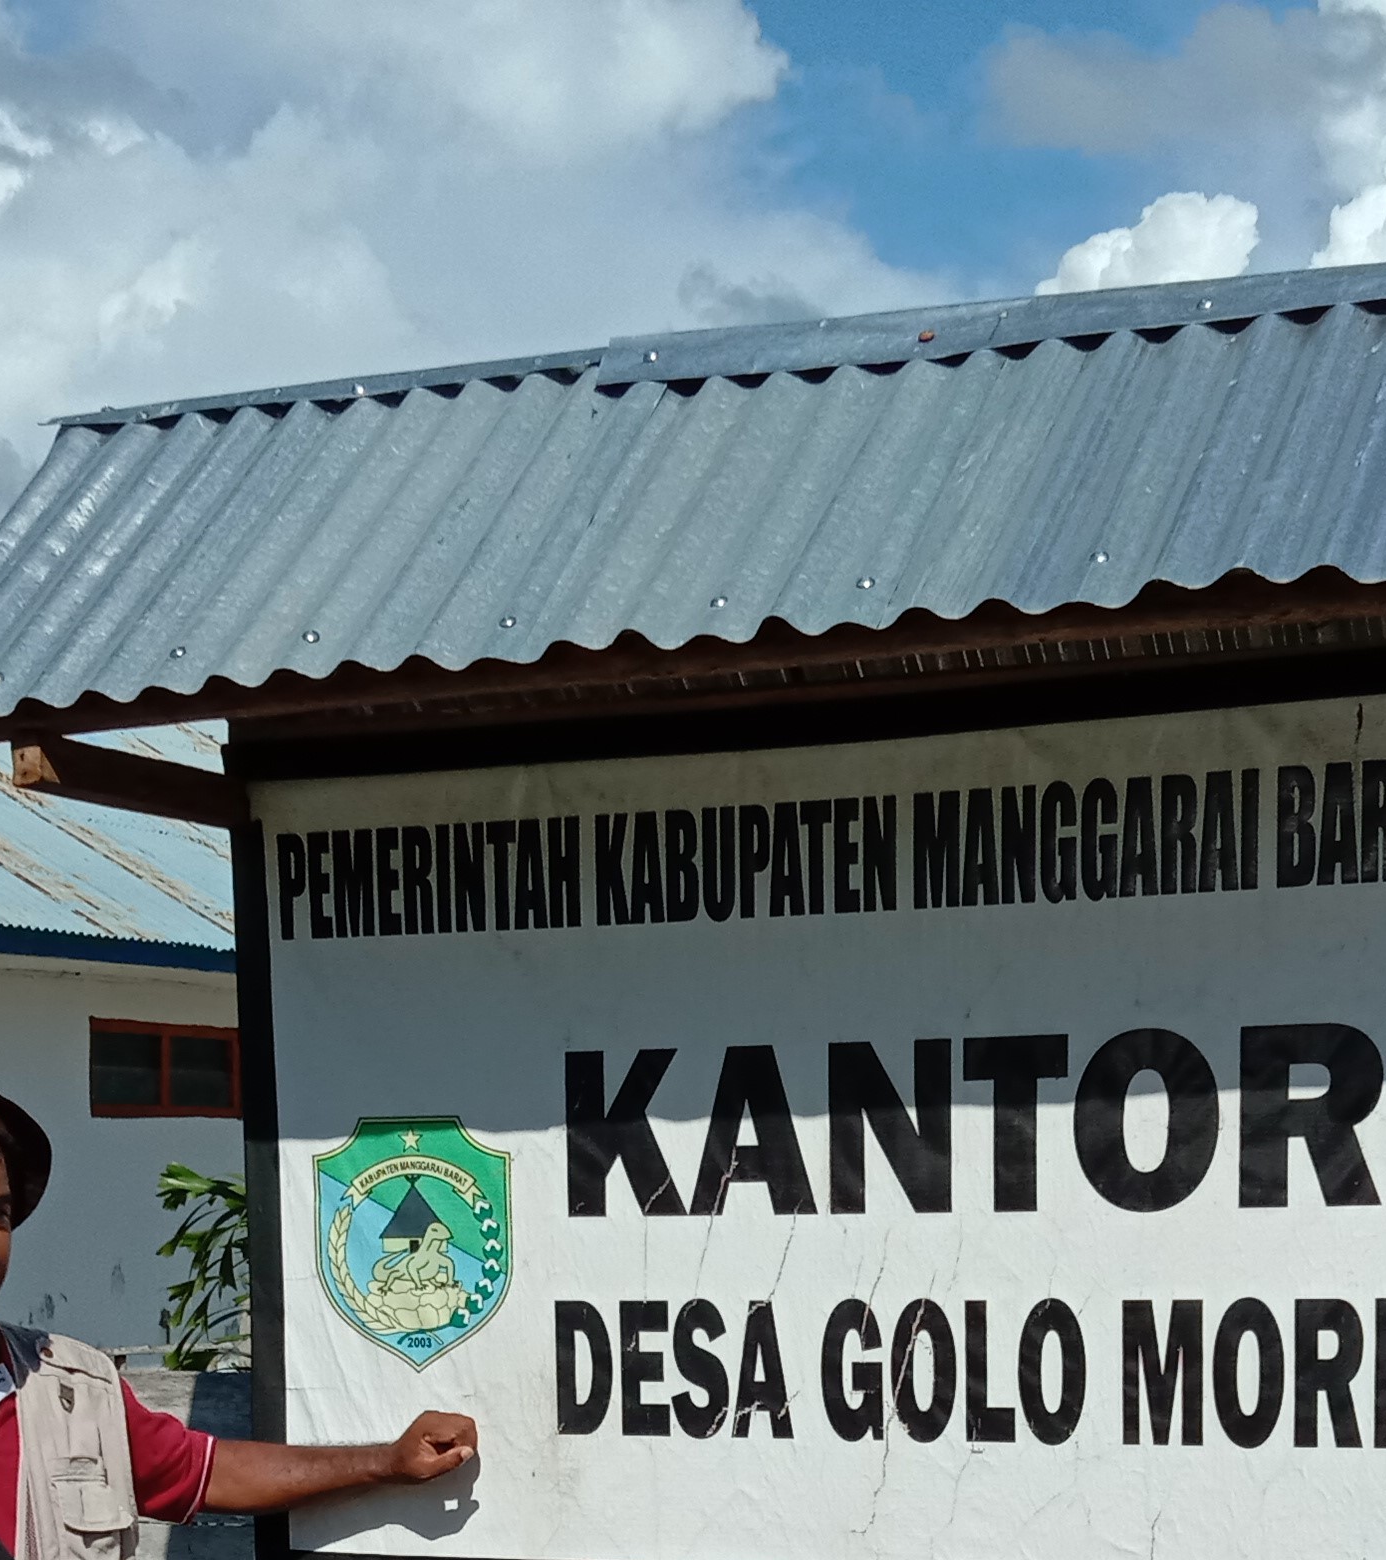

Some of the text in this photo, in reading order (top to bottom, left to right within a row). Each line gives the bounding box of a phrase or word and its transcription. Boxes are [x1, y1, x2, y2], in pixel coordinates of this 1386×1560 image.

[275, 814, 583, 941] PEMERINTAH
[593, 794, 898, 927] KABUPATEN
[912, 767, 1261, 909] MANGGARAI
[358, 1160, 468, 1189] KABUPATEN MANGGARAI BARAT
[564, 1022, 1386, 1217] KANTOR
[407, 1337, 432, 1349] 2003
[553, 1299, 795, 1439] DESA
[820, 1298, 1087, 1446] GOLO
